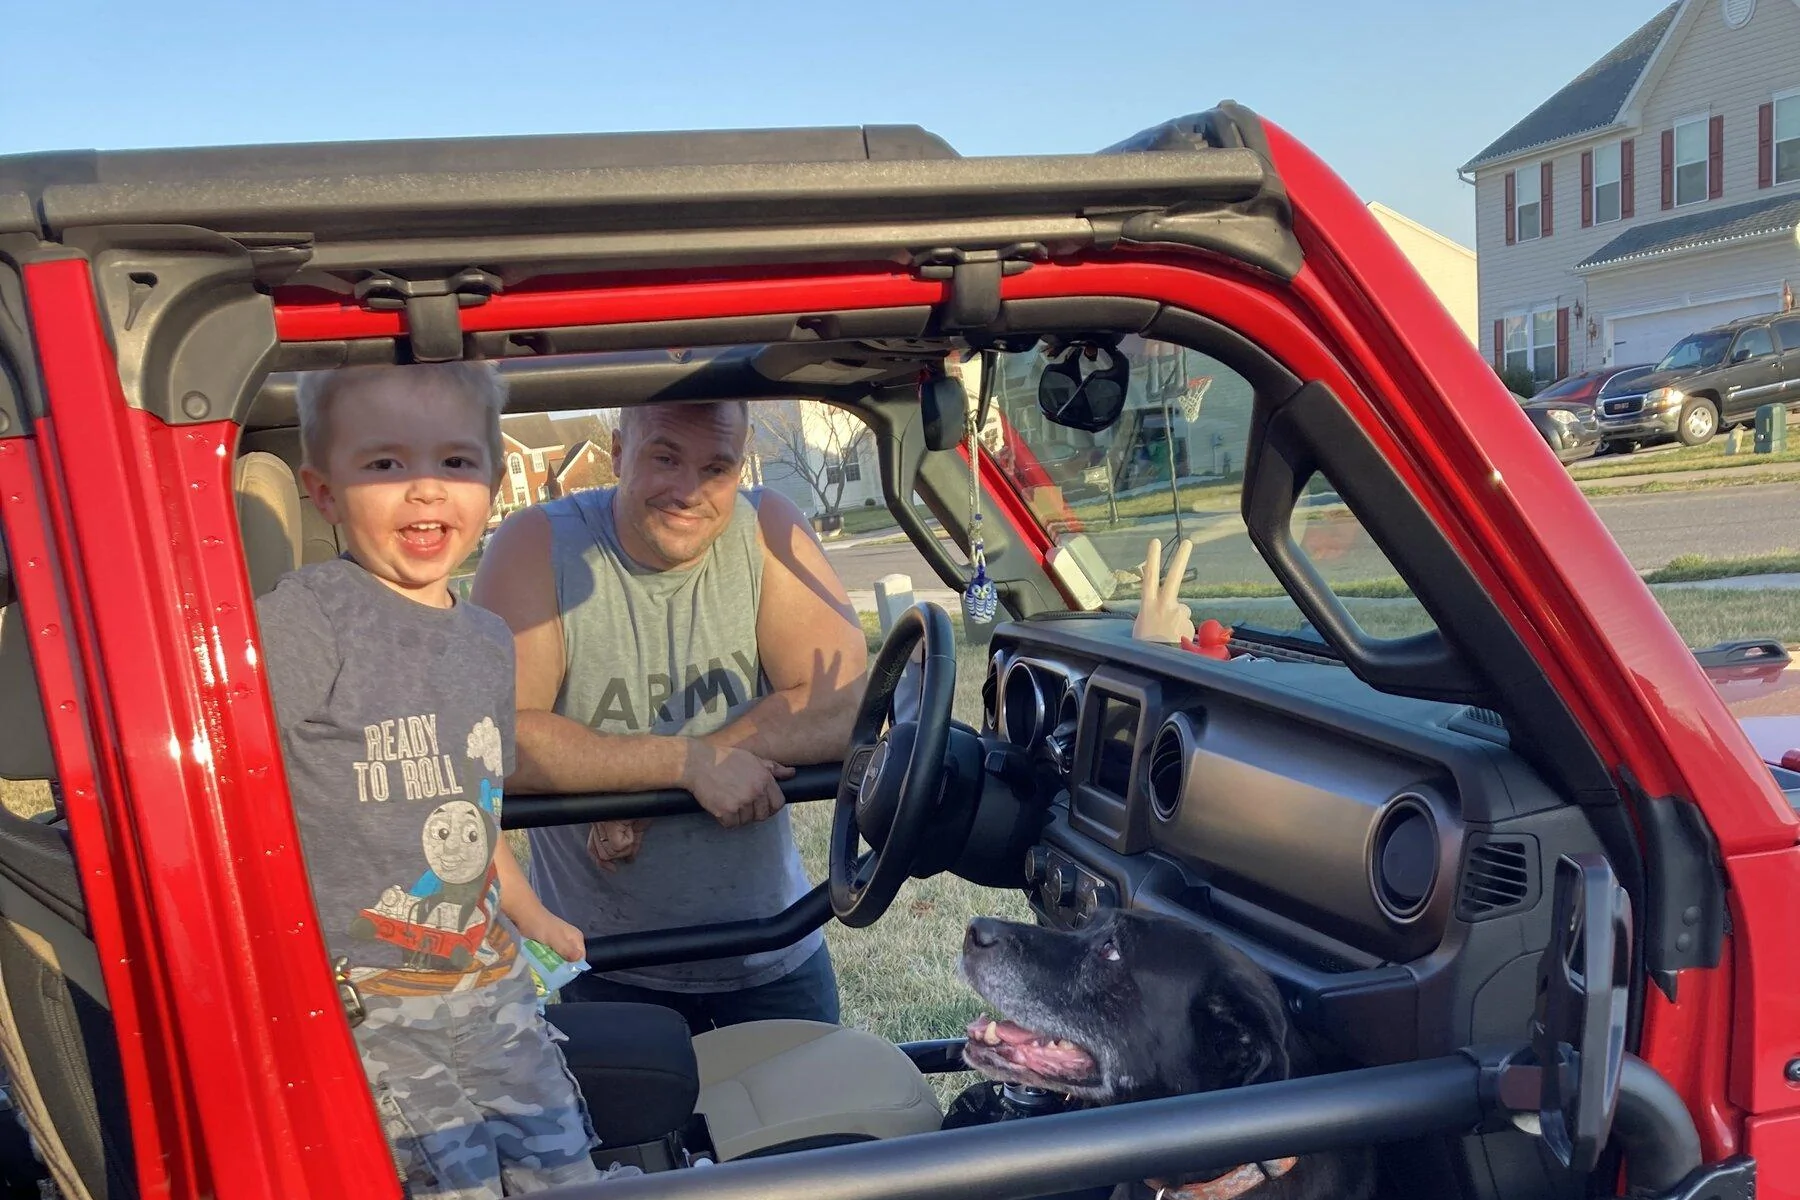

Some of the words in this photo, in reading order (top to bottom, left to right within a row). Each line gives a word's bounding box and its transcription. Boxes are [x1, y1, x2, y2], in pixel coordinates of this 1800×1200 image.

[589, 650, 762, 730] ARMY
[365, 714, 439, 761] READY
[353, 761, 389, 802] TO
[402, 755, 463, 801] ROLL
